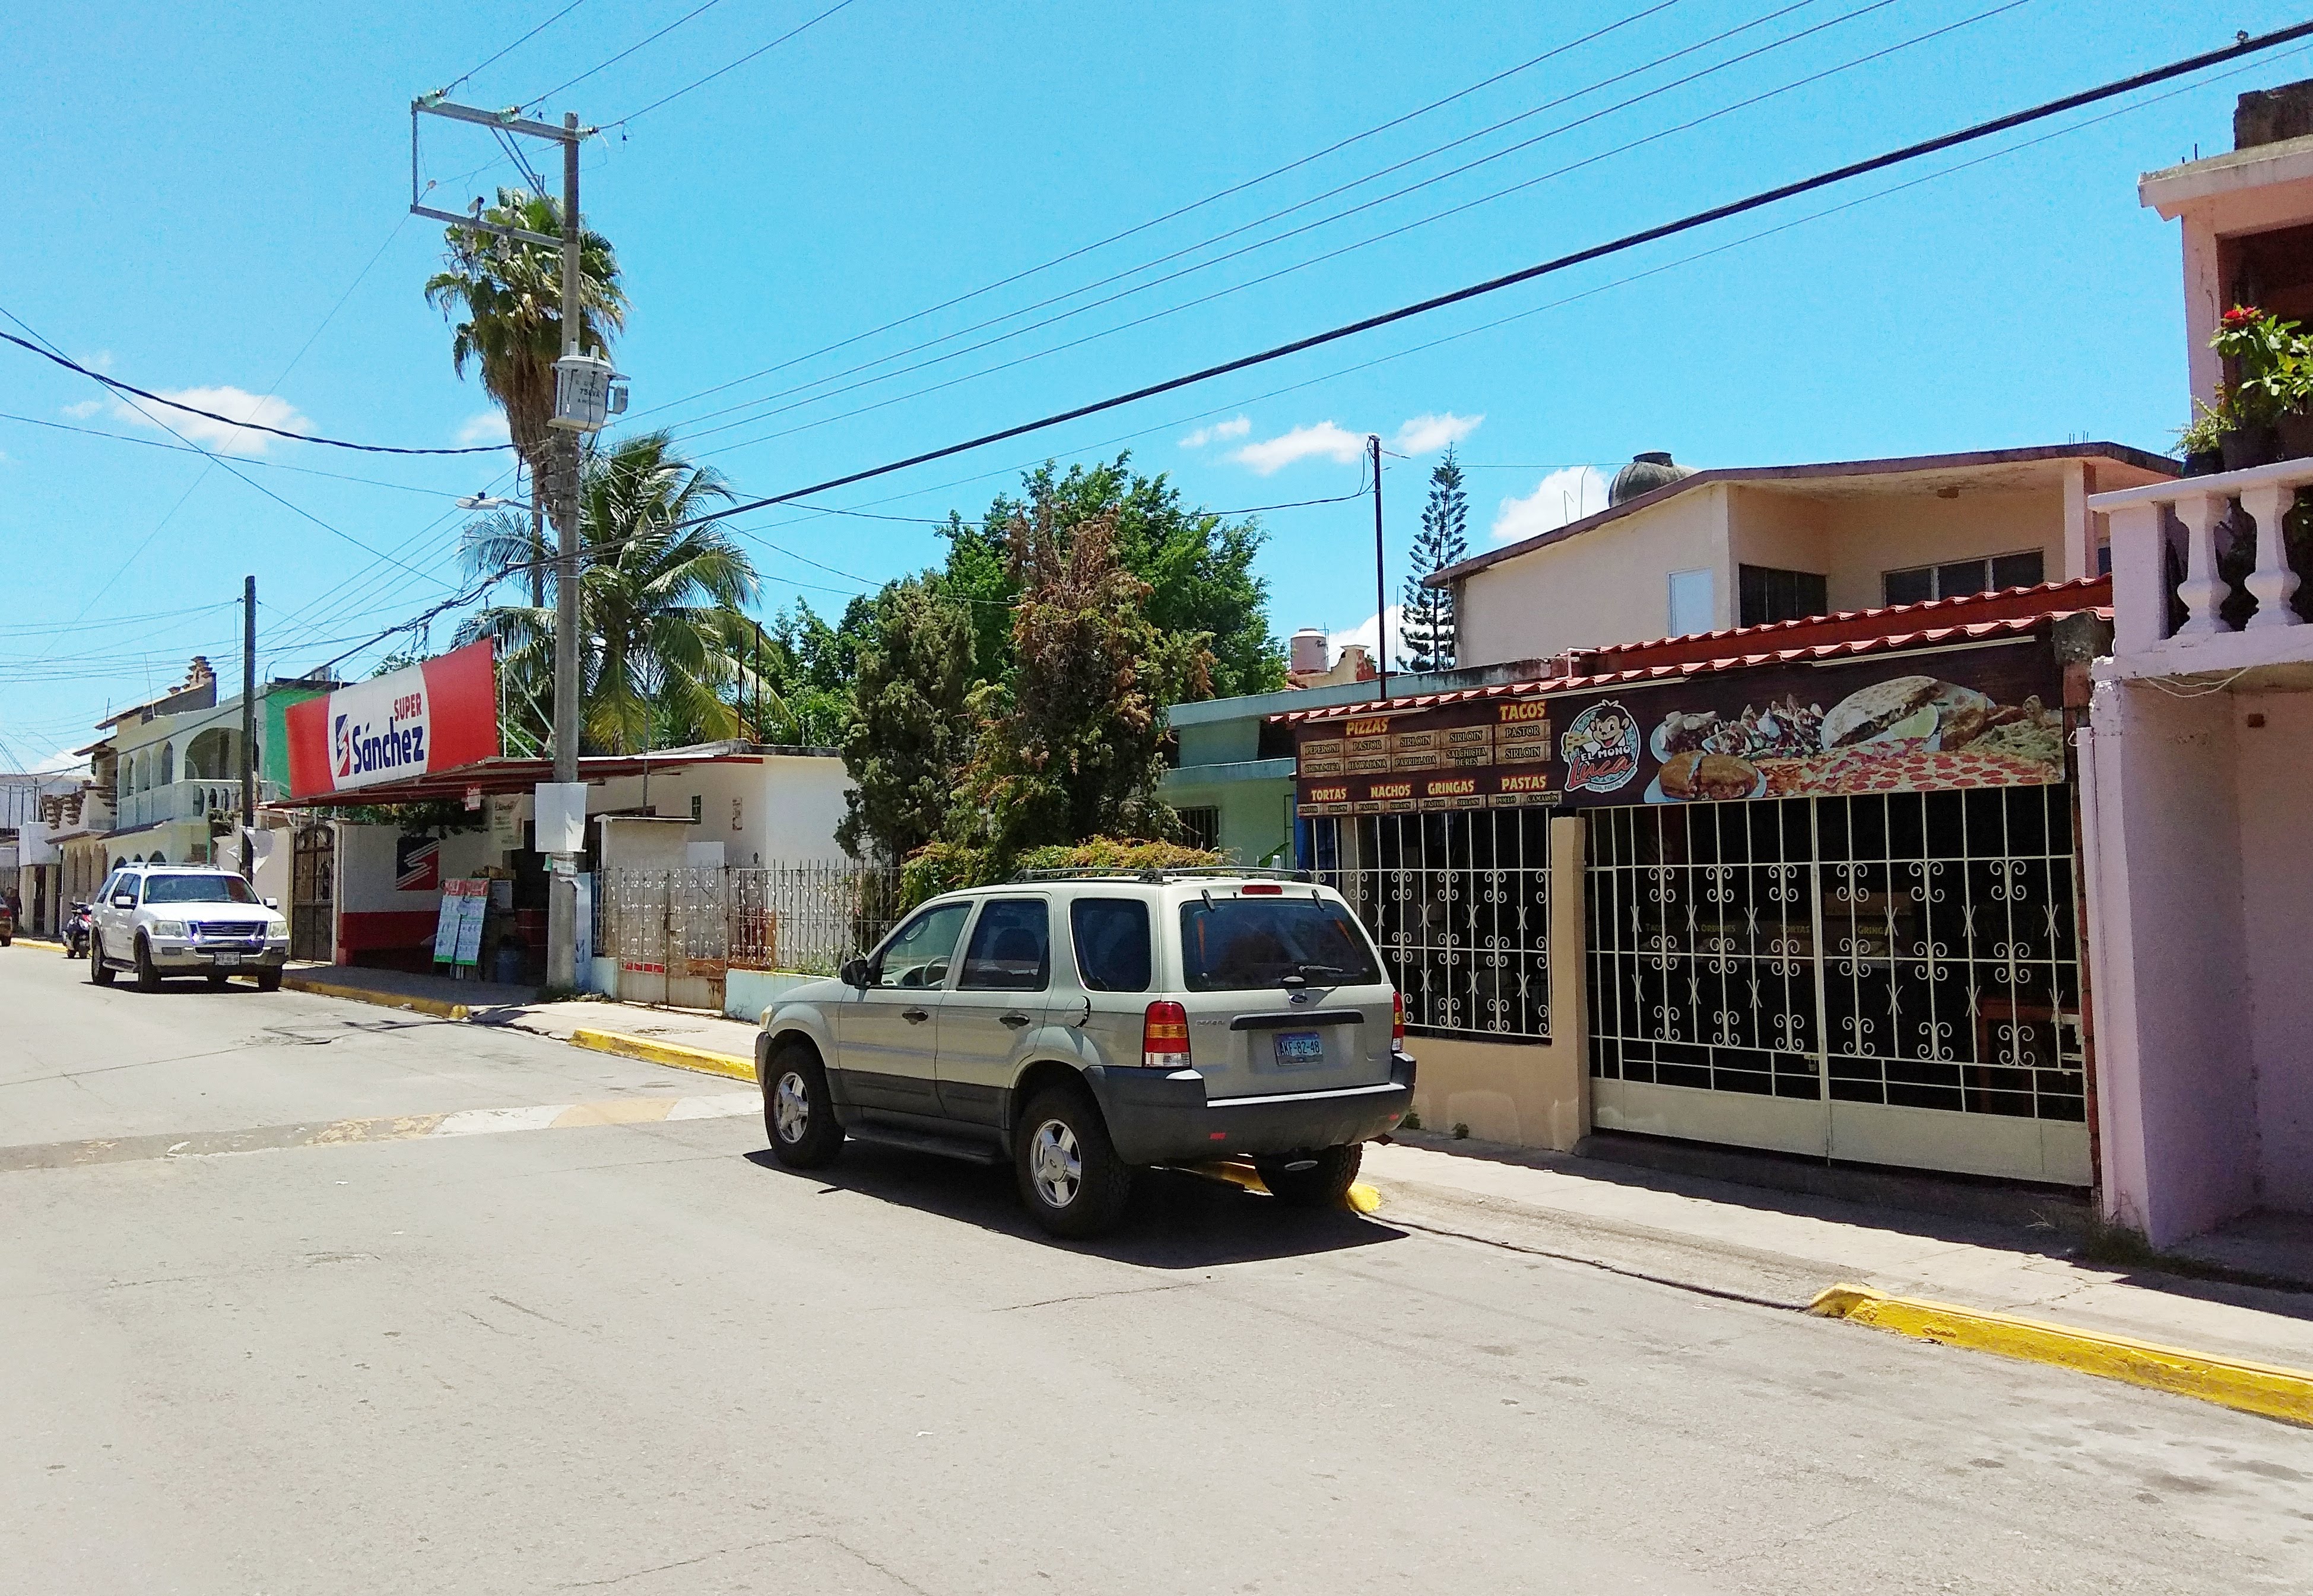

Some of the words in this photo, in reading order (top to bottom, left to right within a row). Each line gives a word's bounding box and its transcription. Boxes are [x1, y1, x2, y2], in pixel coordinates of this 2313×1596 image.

[394, 692, 423, 722] SUPER
[1500, 702, 1546, 721] TACOS
[1346, 718, 1389, 735] PIZZAS
[1505, 725, 1540, 738] PASTOR
[1400, 736, 1431, 747] SIRLOIN
[1449, 731, 1483, 742] SIRLOIN
[353, 716, 425, 775] Sánchez
[1306, 744, 1340, 754] PEPERONI
[1353, 740, 1382, 751] PASTOR
[1446, 747, 1486, 759] SALCHICHA
[1505, 747, 1541, 759] SIRLOIN
[1581, 753, 1594, 761] EL
[1598, 746, 1631, 758] MONO
[1349, 759, 1387, 770] HAWAIANA
[1395, 756, 1436, 766] PARRILLADA
[1455, 759, 1466, 767] DE
[1467, 757, 1478, 766] RES
[1305, 763, 1340, 772] CHINAMECA
[1568, 756, 1635, 788] Luca
[1427, 780, 1474, 795] GRINGAS
[1502, 776, 1546, 791] PASTAS
[1311, 788, 1347, 801] TORTAS
[1370, 784, 1411, 798] NACHOS
[1496, 796, 1516, 804] POLLO
[1527, 793, 1558, 802] CAMARÓN
